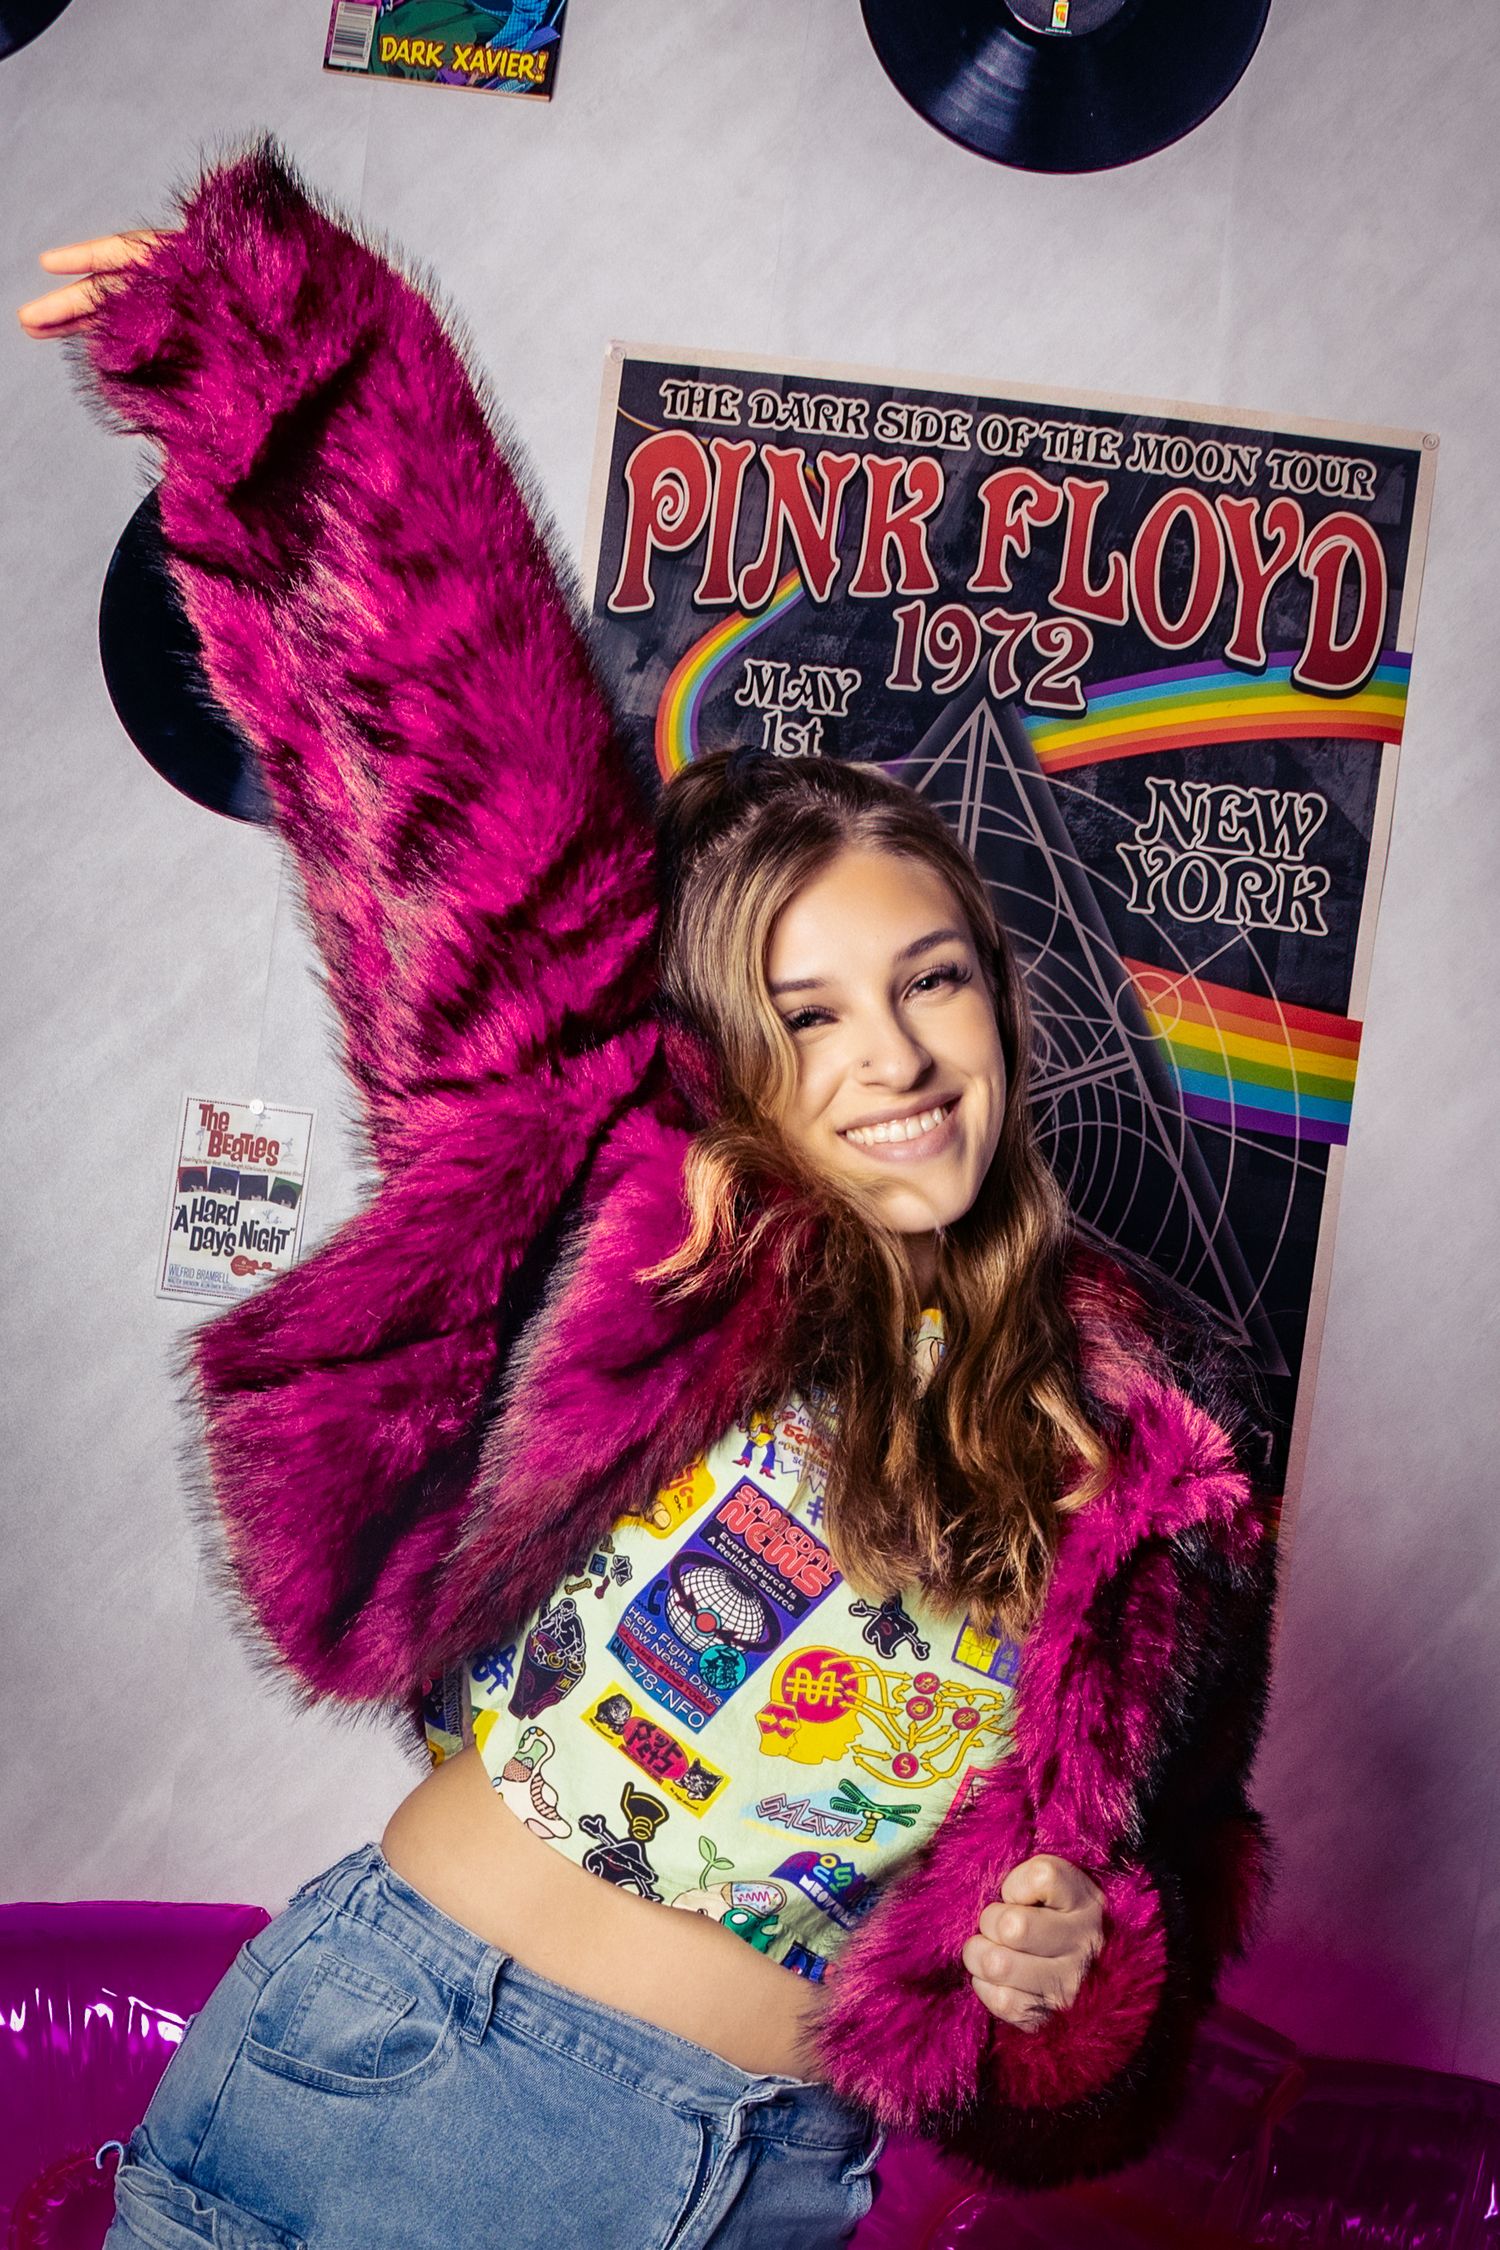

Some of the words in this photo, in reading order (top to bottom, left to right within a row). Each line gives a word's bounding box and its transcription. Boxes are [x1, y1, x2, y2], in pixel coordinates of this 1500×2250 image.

[381, 36, 443, 68] DARK
[452, 45, 547, 82] XAVIER!
[660, 380, 742, 425] THE
[748, 389, 868, 437] DARK
[875, 401, 972, 452] SIDE
[977, 413, 1040, 457] OF
[1038, 423, 1123, 468] THE
[1129, 433, 1260, 485] MOON
[1266, 448, 1377, 501] TOUR
[607, 429, 945, 614] PINK
[966, 466, 1389, 693] FLOYD
[735, 658, 862, 717] MAY
[886, 599, 1094, 712] 1972
[762, 710, 826, 760] 1st
[1137, 777, 1328, 862] NEW
[1116, 843, 1332, 937] YORK
[199, 1103, 230, 1132] The
[706, 1535, 716, 1547] A
[715, 1543, 759, 1582] Reliable
[758, 1579, 796, 1612] Source
[716, 1499, 833, 1598] NEWS
[719, 1531, 750, 1560] Every
[749, 1557, 787, 1592] Source
[623, 1616, 651, 1644] Slow
[650, 1642, 688, 1677] News
[688, 1673, 723, 1706] Days
[628, 1606, 658, 1636] Help
[658, 1632, 695, 1667] Fight
[625, 1656, 705, 1728] 278-NFO
